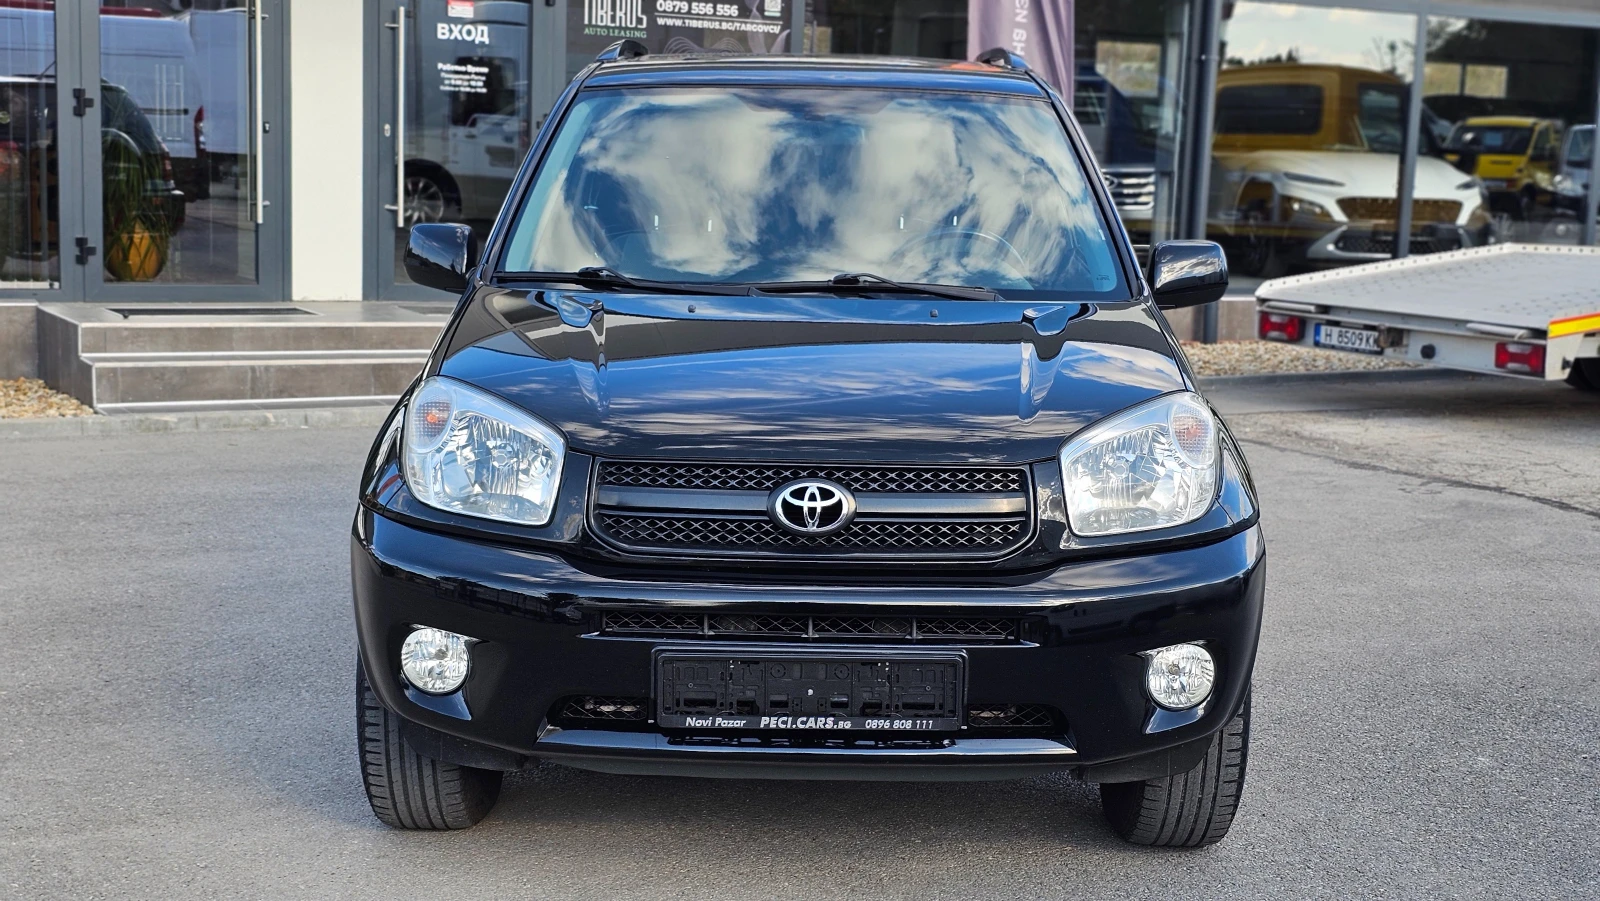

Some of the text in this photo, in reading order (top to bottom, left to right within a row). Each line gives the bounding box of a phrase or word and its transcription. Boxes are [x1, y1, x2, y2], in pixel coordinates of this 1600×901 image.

[656, 0, 739, 17] 0879 556 556
[437, 23, 489, 44] ВХОД
[584, 28, 647, 38] AUTO LEASING
[685, 716, 933, 729] Novi Pazar PECI.CARS.BG 0896 808 111
